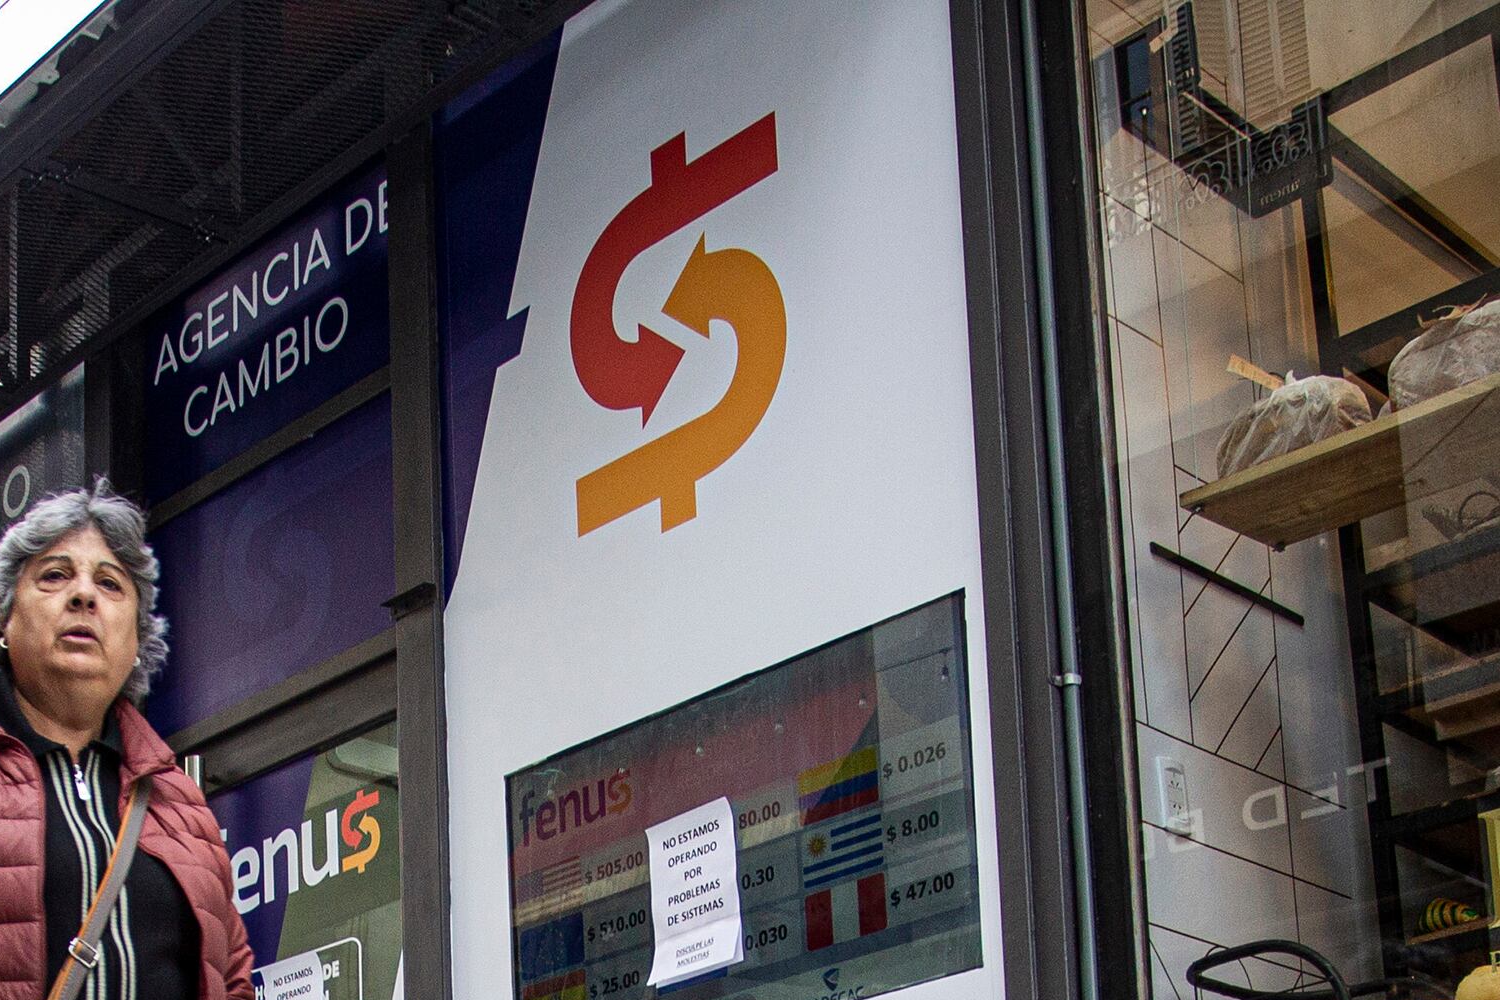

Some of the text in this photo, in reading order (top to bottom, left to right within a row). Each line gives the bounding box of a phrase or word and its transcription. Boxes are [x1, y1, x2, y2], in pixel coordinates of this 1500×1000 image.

[154, 228, 331, 386] AGENCIA
[184, 297, 349, 437] CAMBIO
[898, 742, 946, 774] 0.026
[662, 819, 720, 851] NO ESTAMOS
[901, 810, 940, 837] 8.00
[220, 790, 381, 914] enus
[596, 851, 644, 878] 505.00
[667, 841, 718, 868] OPERANDO
[684, 866, 702, 881] POR
[905, 872, 955, 900] 47.00
[667, 878, 721, 907] PROBLEMAS
[599, 909, 647, 936] 510.00
[667, 897, 725, 927] DE SISTEMAS
[273, 966, 313, 988] NO ESTAMOS
[602, 970, 641, 994] 25.00
